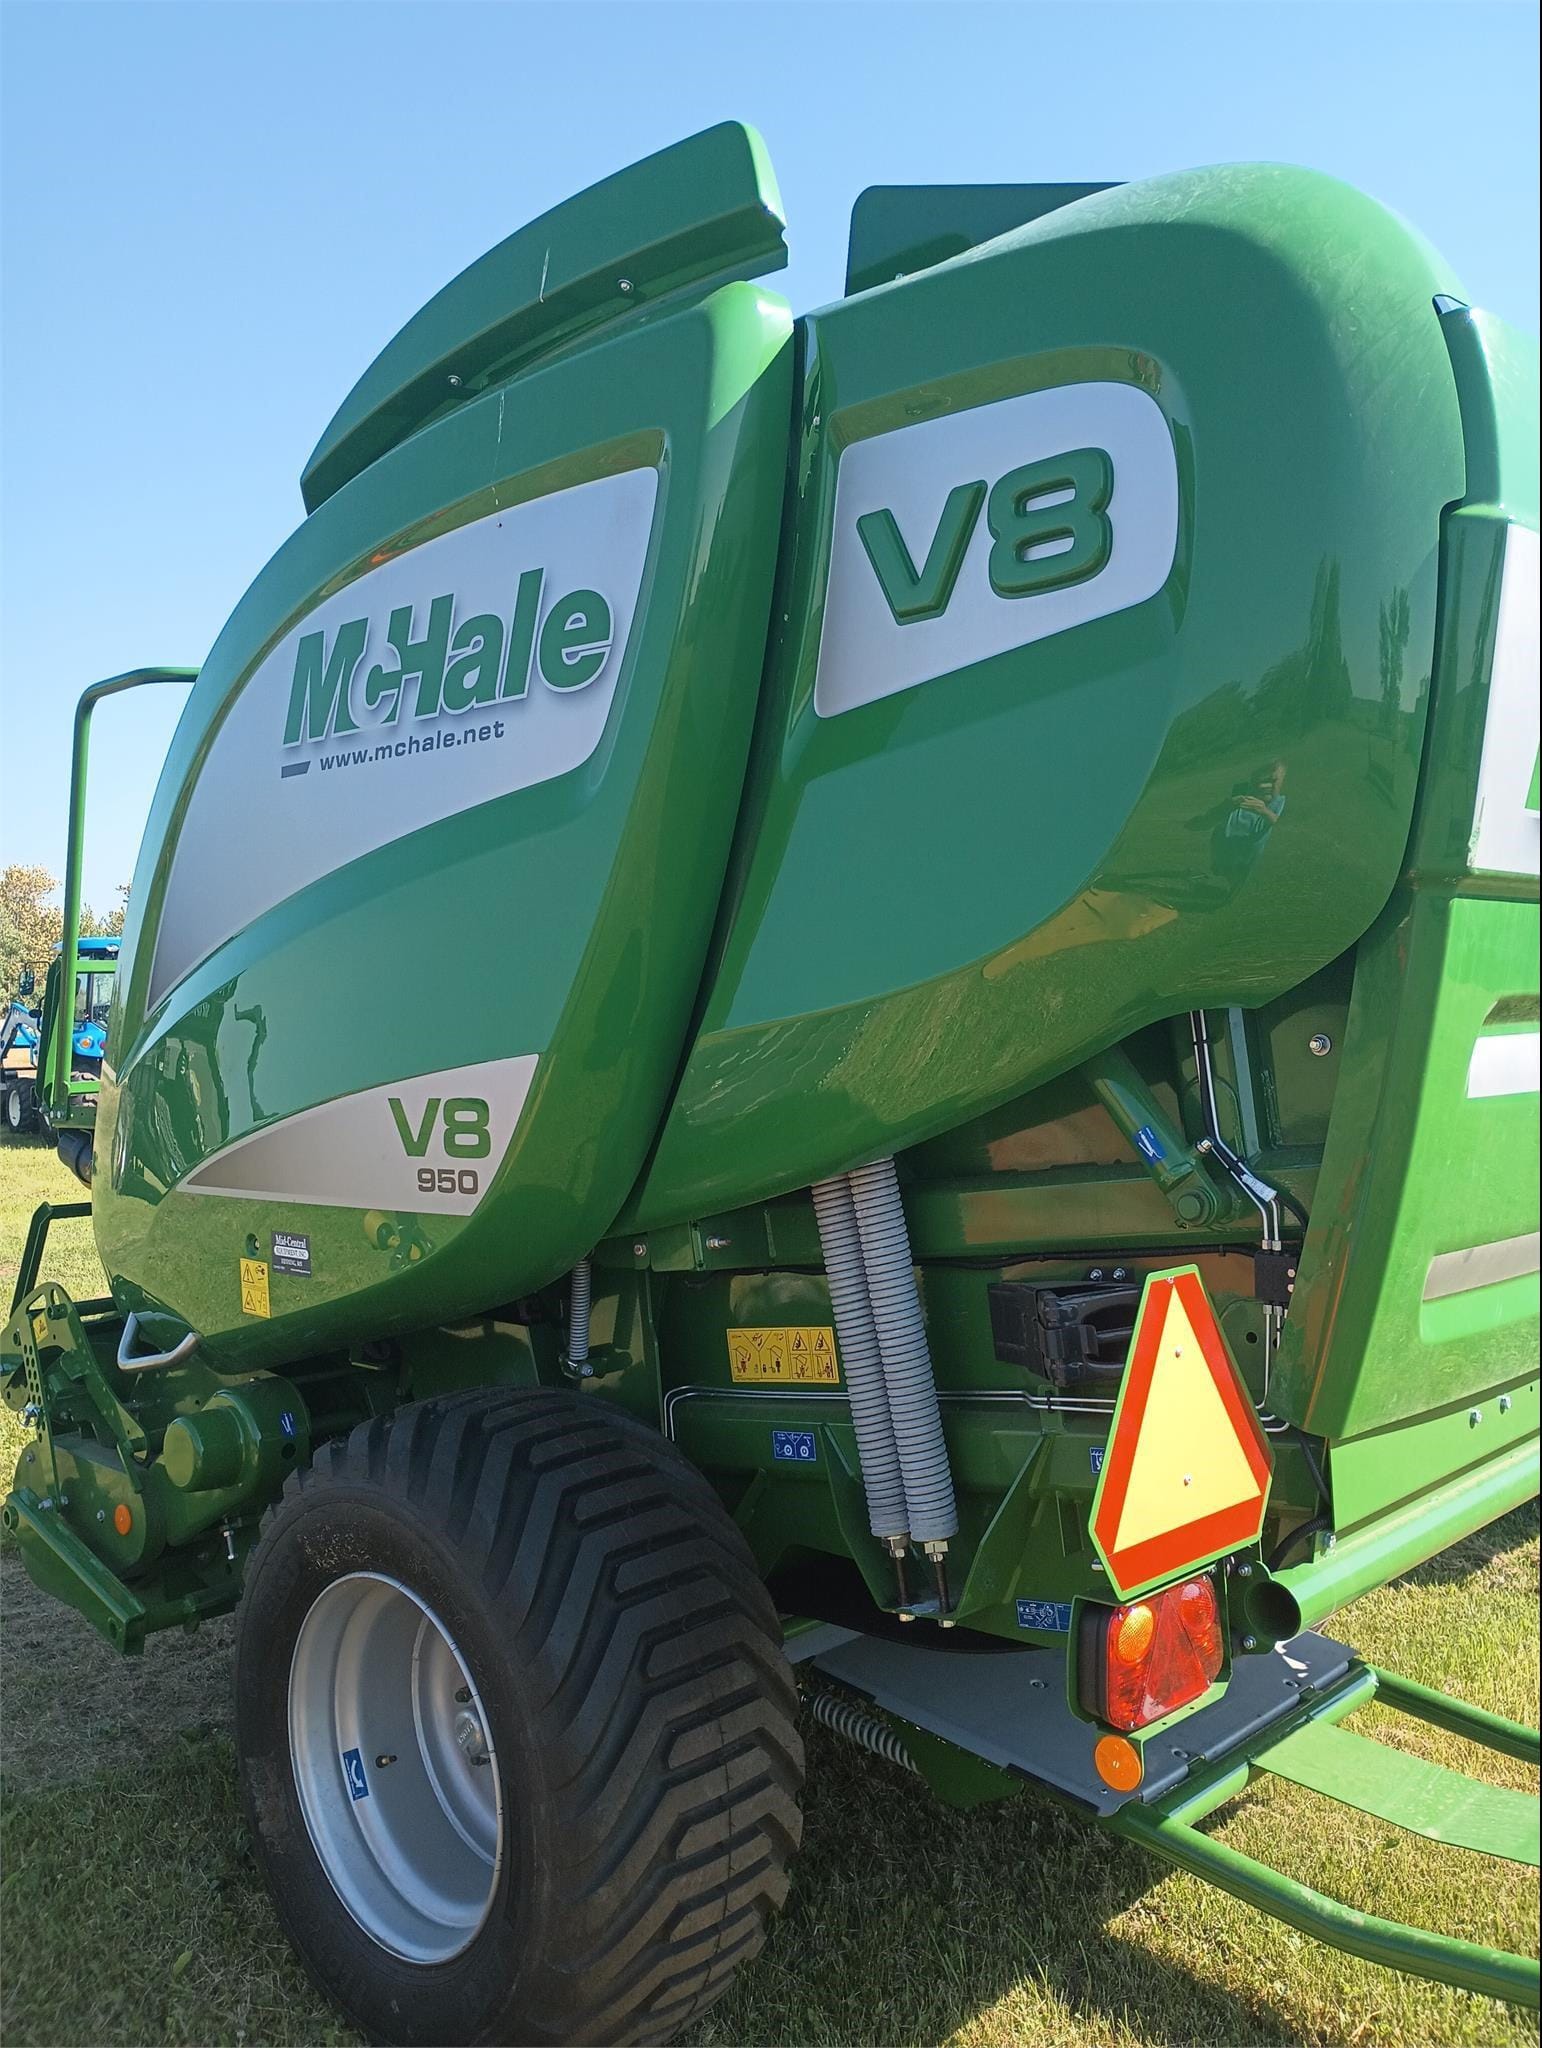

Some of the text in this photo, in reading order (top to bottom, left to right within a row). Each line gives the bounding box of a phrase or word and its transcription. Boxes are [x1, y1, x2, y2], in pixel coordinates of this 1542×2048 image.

[856, 447, 1114, 626] V8
[283, 567, 612, 745] McHale
[319, 720, 505, 771] www.mchale.net
[387, 1097, 491, 1159] V8
[417, 1168, 479, 1195] 950
[275, 1234, 307, 1249] Mid-Central
